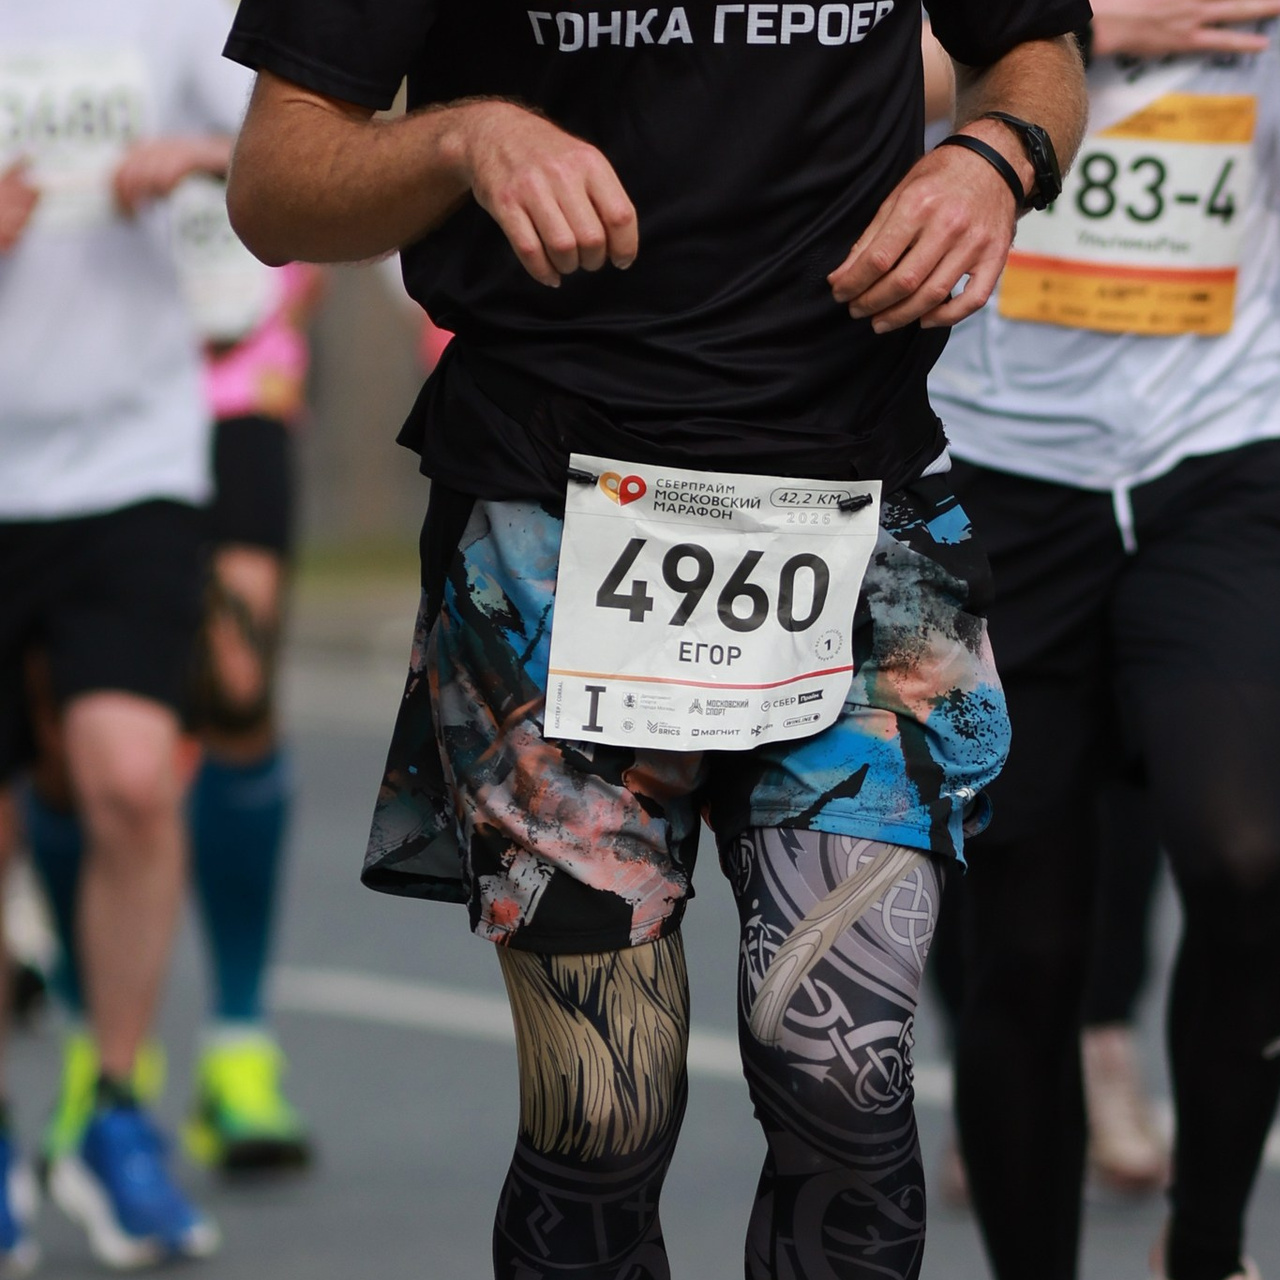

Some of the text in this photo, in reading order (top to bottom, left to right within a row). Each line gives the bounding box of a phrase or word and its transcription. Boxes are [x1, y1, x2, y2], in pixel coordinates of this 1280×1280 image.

[527, 6, 693, 52] ГОНКА
[1046, 151, 1236, 226] 83-4
[656, 478, 735, 495] СБЕРПРАЙМ
[654, 489, 761, 510] МОСКОВСКИЙ
[778, 492, 812, 505] 42,2
[653, 501, 733, 520] МАРАФОН
[786, 512, 831, 525] 2026
[596, 538, 830, 633] 4960
[678, 641, 742, 666] ЕГОР
[824, 638, 832, 651] 1
[582, 685, 606, 732] I
[773, 697, 796, 708] СБЕР
[658, 728, 681, 736] BRICS
